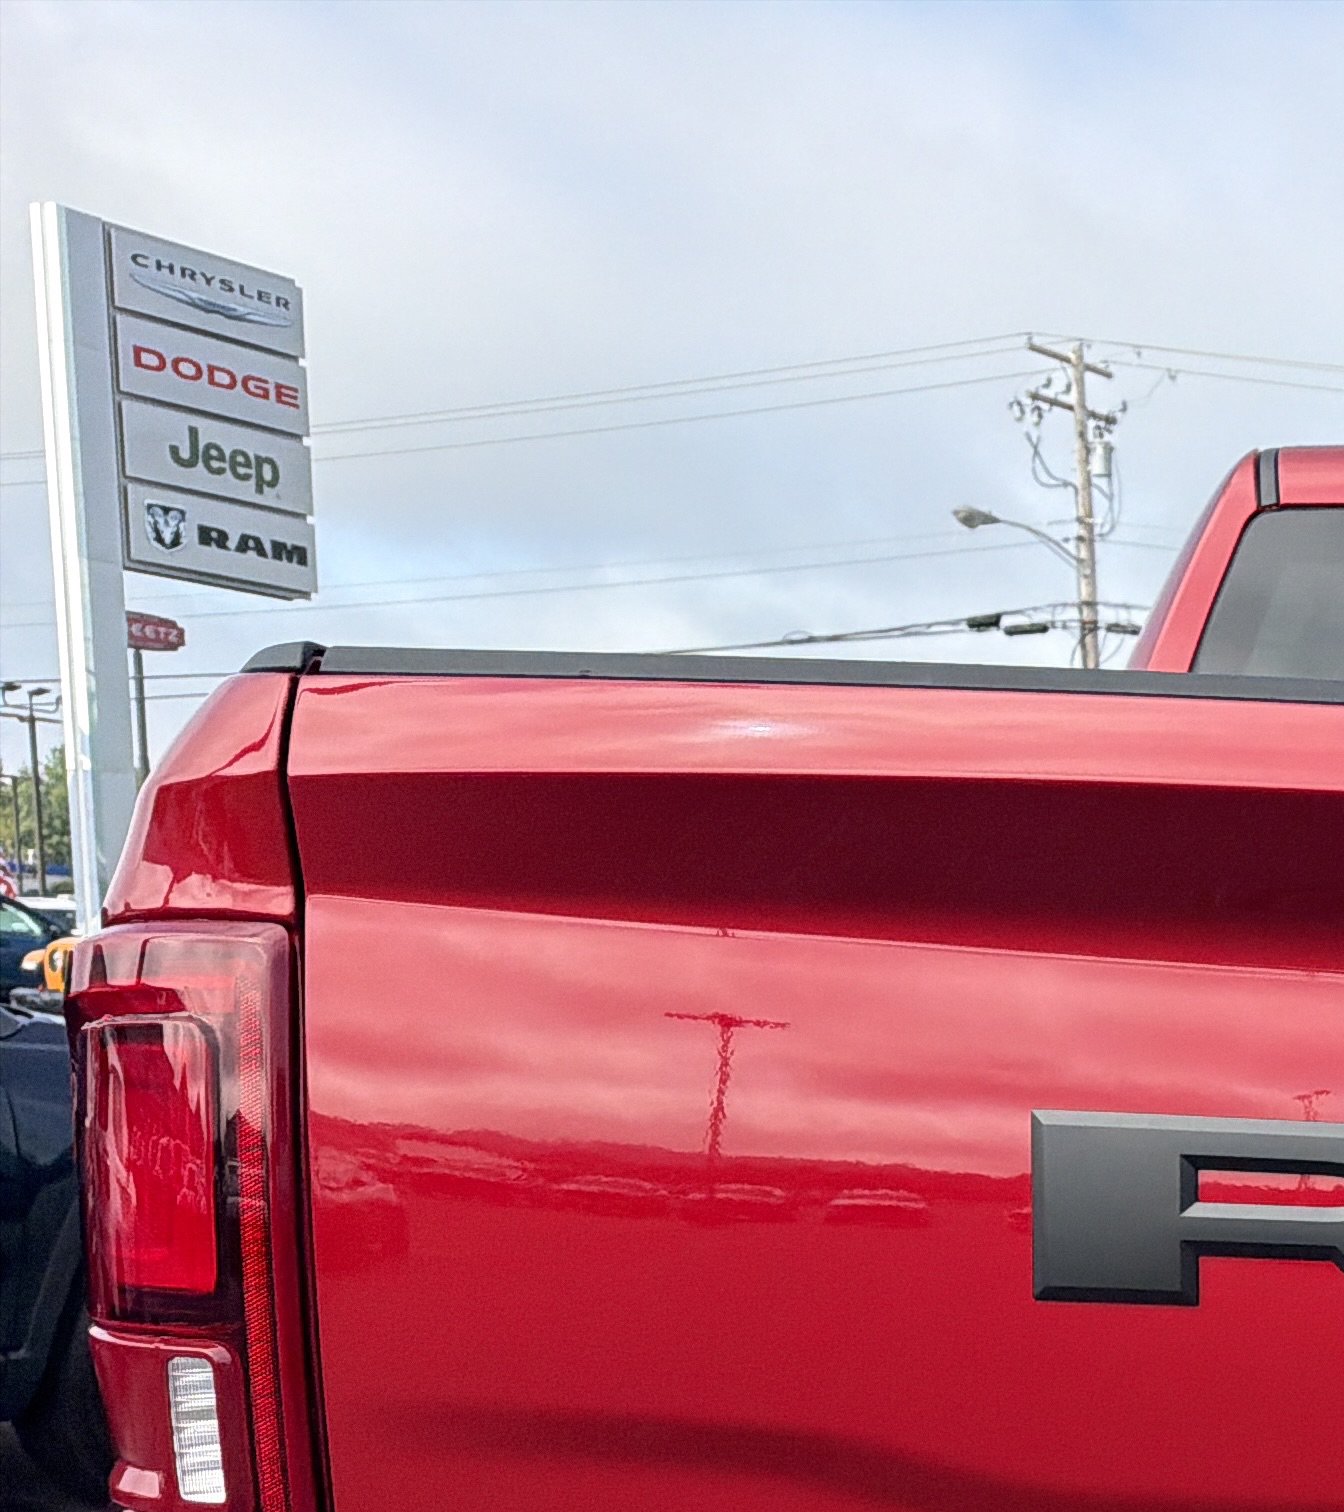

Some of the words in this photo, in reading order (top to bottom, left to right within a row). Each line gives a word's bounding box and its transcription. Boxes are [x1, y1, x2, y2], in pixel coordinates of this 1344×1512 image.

[130, 253, 292, 312] CHRYSLER
[132, 344, 300, 410] DODGE
[168, 424, 281, 496] Jeep
[197, 523, 309, 568] RAM
